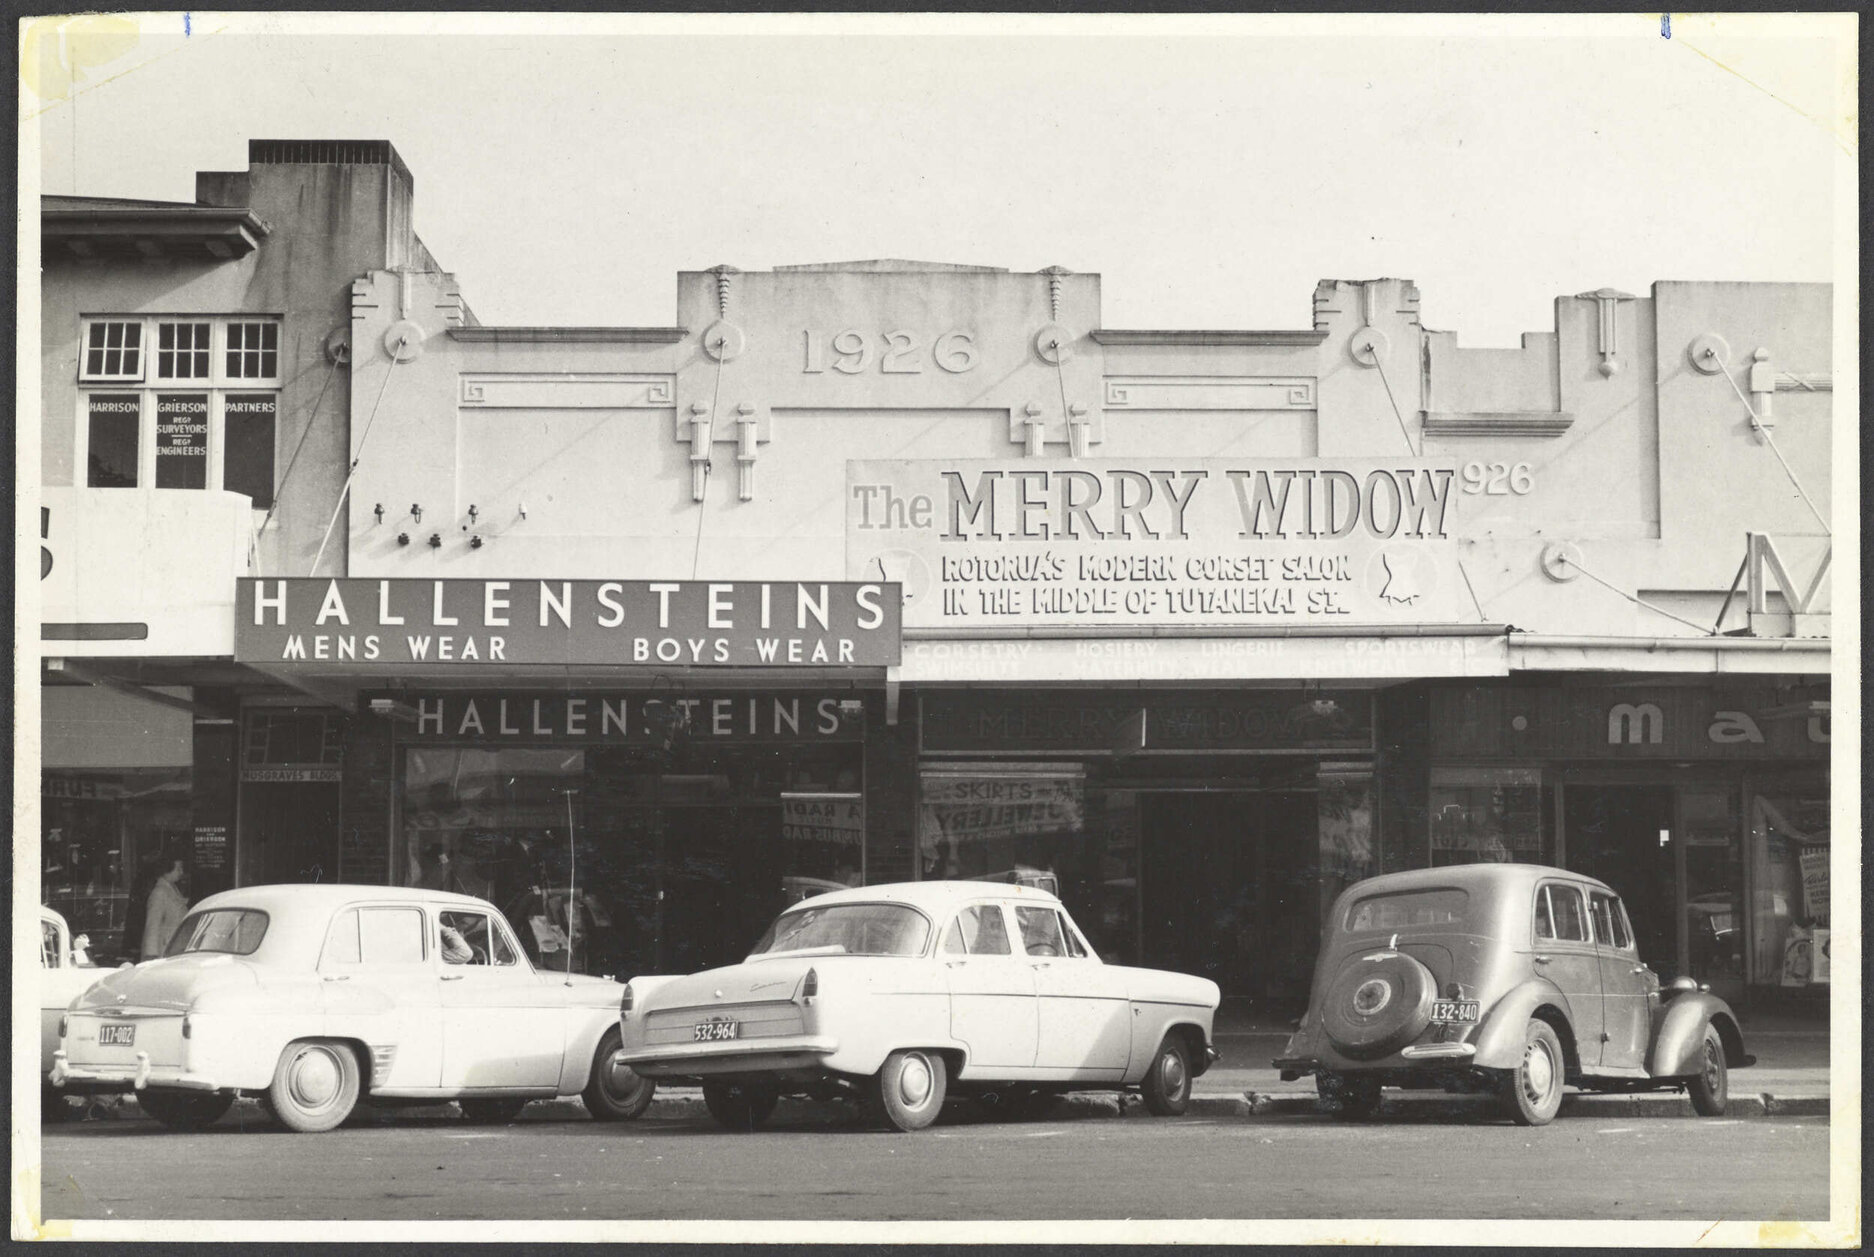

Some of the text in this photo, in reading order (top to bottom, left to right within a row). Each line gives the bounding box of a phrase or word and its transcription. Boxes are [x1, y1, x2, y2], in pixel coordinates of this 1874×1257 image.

[801, 329, 982, 376] 1926
[89, 403, 276, 413] HARRISON GRIERSON PARTNERS
[156, 424, 207, 434] SURVEYORS
[156, 446, 206, 456] ENGINEERS
[853, 469, 1456, 542] The MERRY WIDOW
[942, 551, 1352, 582] ROTORUA'S MODERN CORSET SALON
[254, 578, 885, 631] HALLENSTEINS
[943, 587, 968, 615] IN
[979, 587, 1022, 615] THE
[1032, 587, 1117, 615] MIDDLE
[1125, 587, 1158, 615] OF
[1165, 587, 1296, 615] TUTANEKAI
[282, 634, 506, 661] MENS WEAR
[633, 637, 855, 663] BOYS WEAR
[914, 641, 1477, 659] CORSETRY HOSIERY LINGERIE SPORTSWEAR
[952, 782, 1033, 799] SKIRTS
